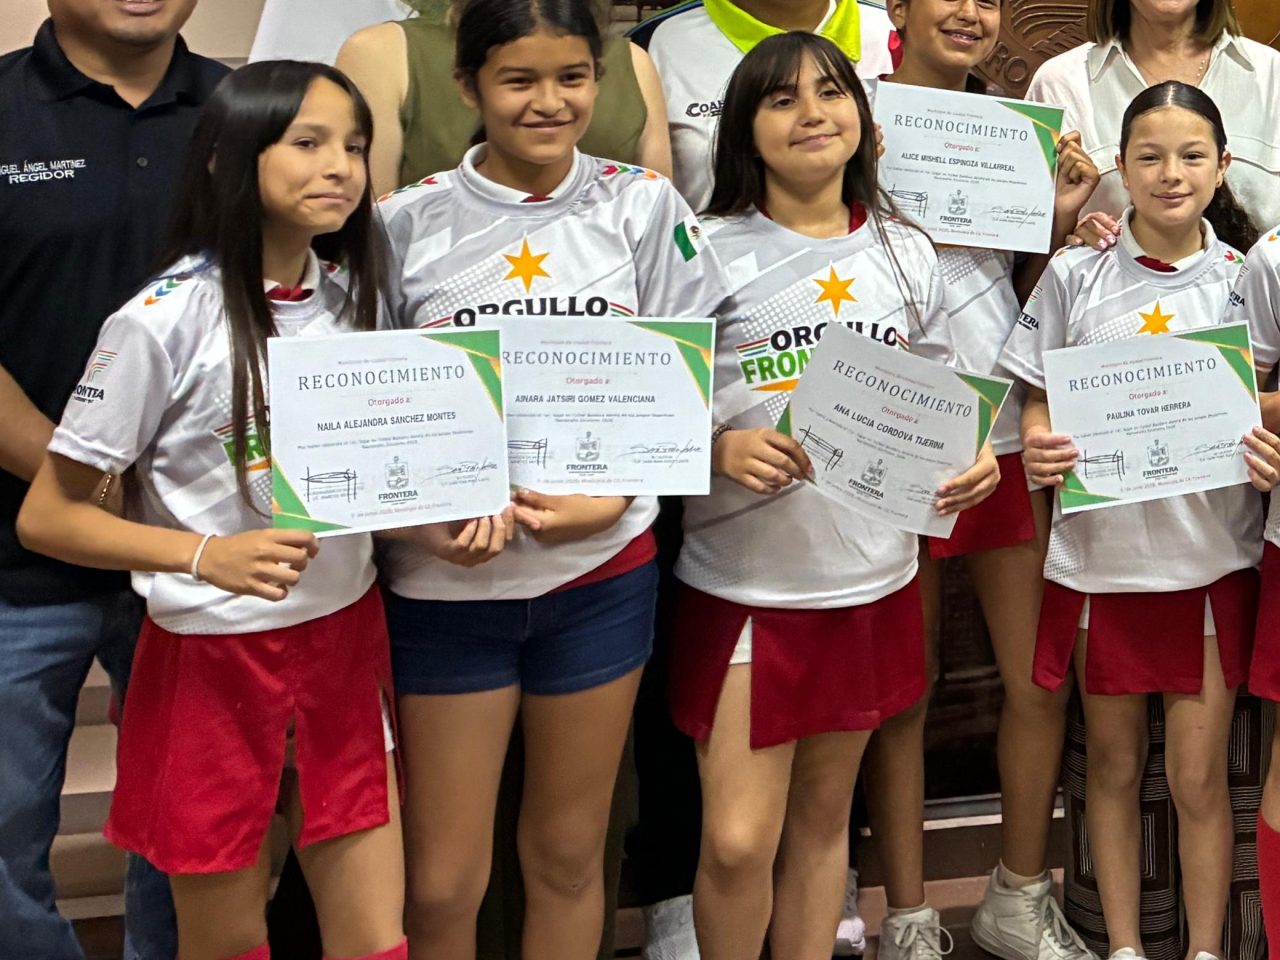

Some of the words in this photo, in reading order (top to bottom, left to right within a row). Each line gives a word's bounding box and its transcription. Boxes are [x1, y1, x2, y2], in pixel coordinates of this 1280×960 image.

[893, 113, 1028, 142] RECONOCIMIENTO
[901, 152, 919, 160] ALICE
[9, 170, 75, 184] REGIDOR
[939, 215, 972, 223] FRONTERA
[502, 351, 671, 365] RECONOCIMIENTO
[298, 364, 465, 390] RECONOCIMIENTO
[1068, 357, 1216, 391] RECONOCIMIENTO
[833, 359, 972, 418] RECONOCIMIENTO
[1106, 409, 1134, 420] PAULINA
[1137, 406, 1158, 415] TOVAR
[1161, 401, 1191, 412] HERRERA
[317, 421, 341, 432] NAILA
[343, 417, 387, 429] ALEJANDRA
[390, 414, 424, 425] SANCHEZ
[426, 411, 456, 422] MONTES
[833, 403, 850, 417] ANA
[851, 411, 875, 428] LUCIA
[876, 422, 913, 442] CORDOVA
[1142, 466, 1178, 477] FRONTERA
[378, 489, 418, 501] FRONTERA
[848, 478, 884, 499] FRONTERA
